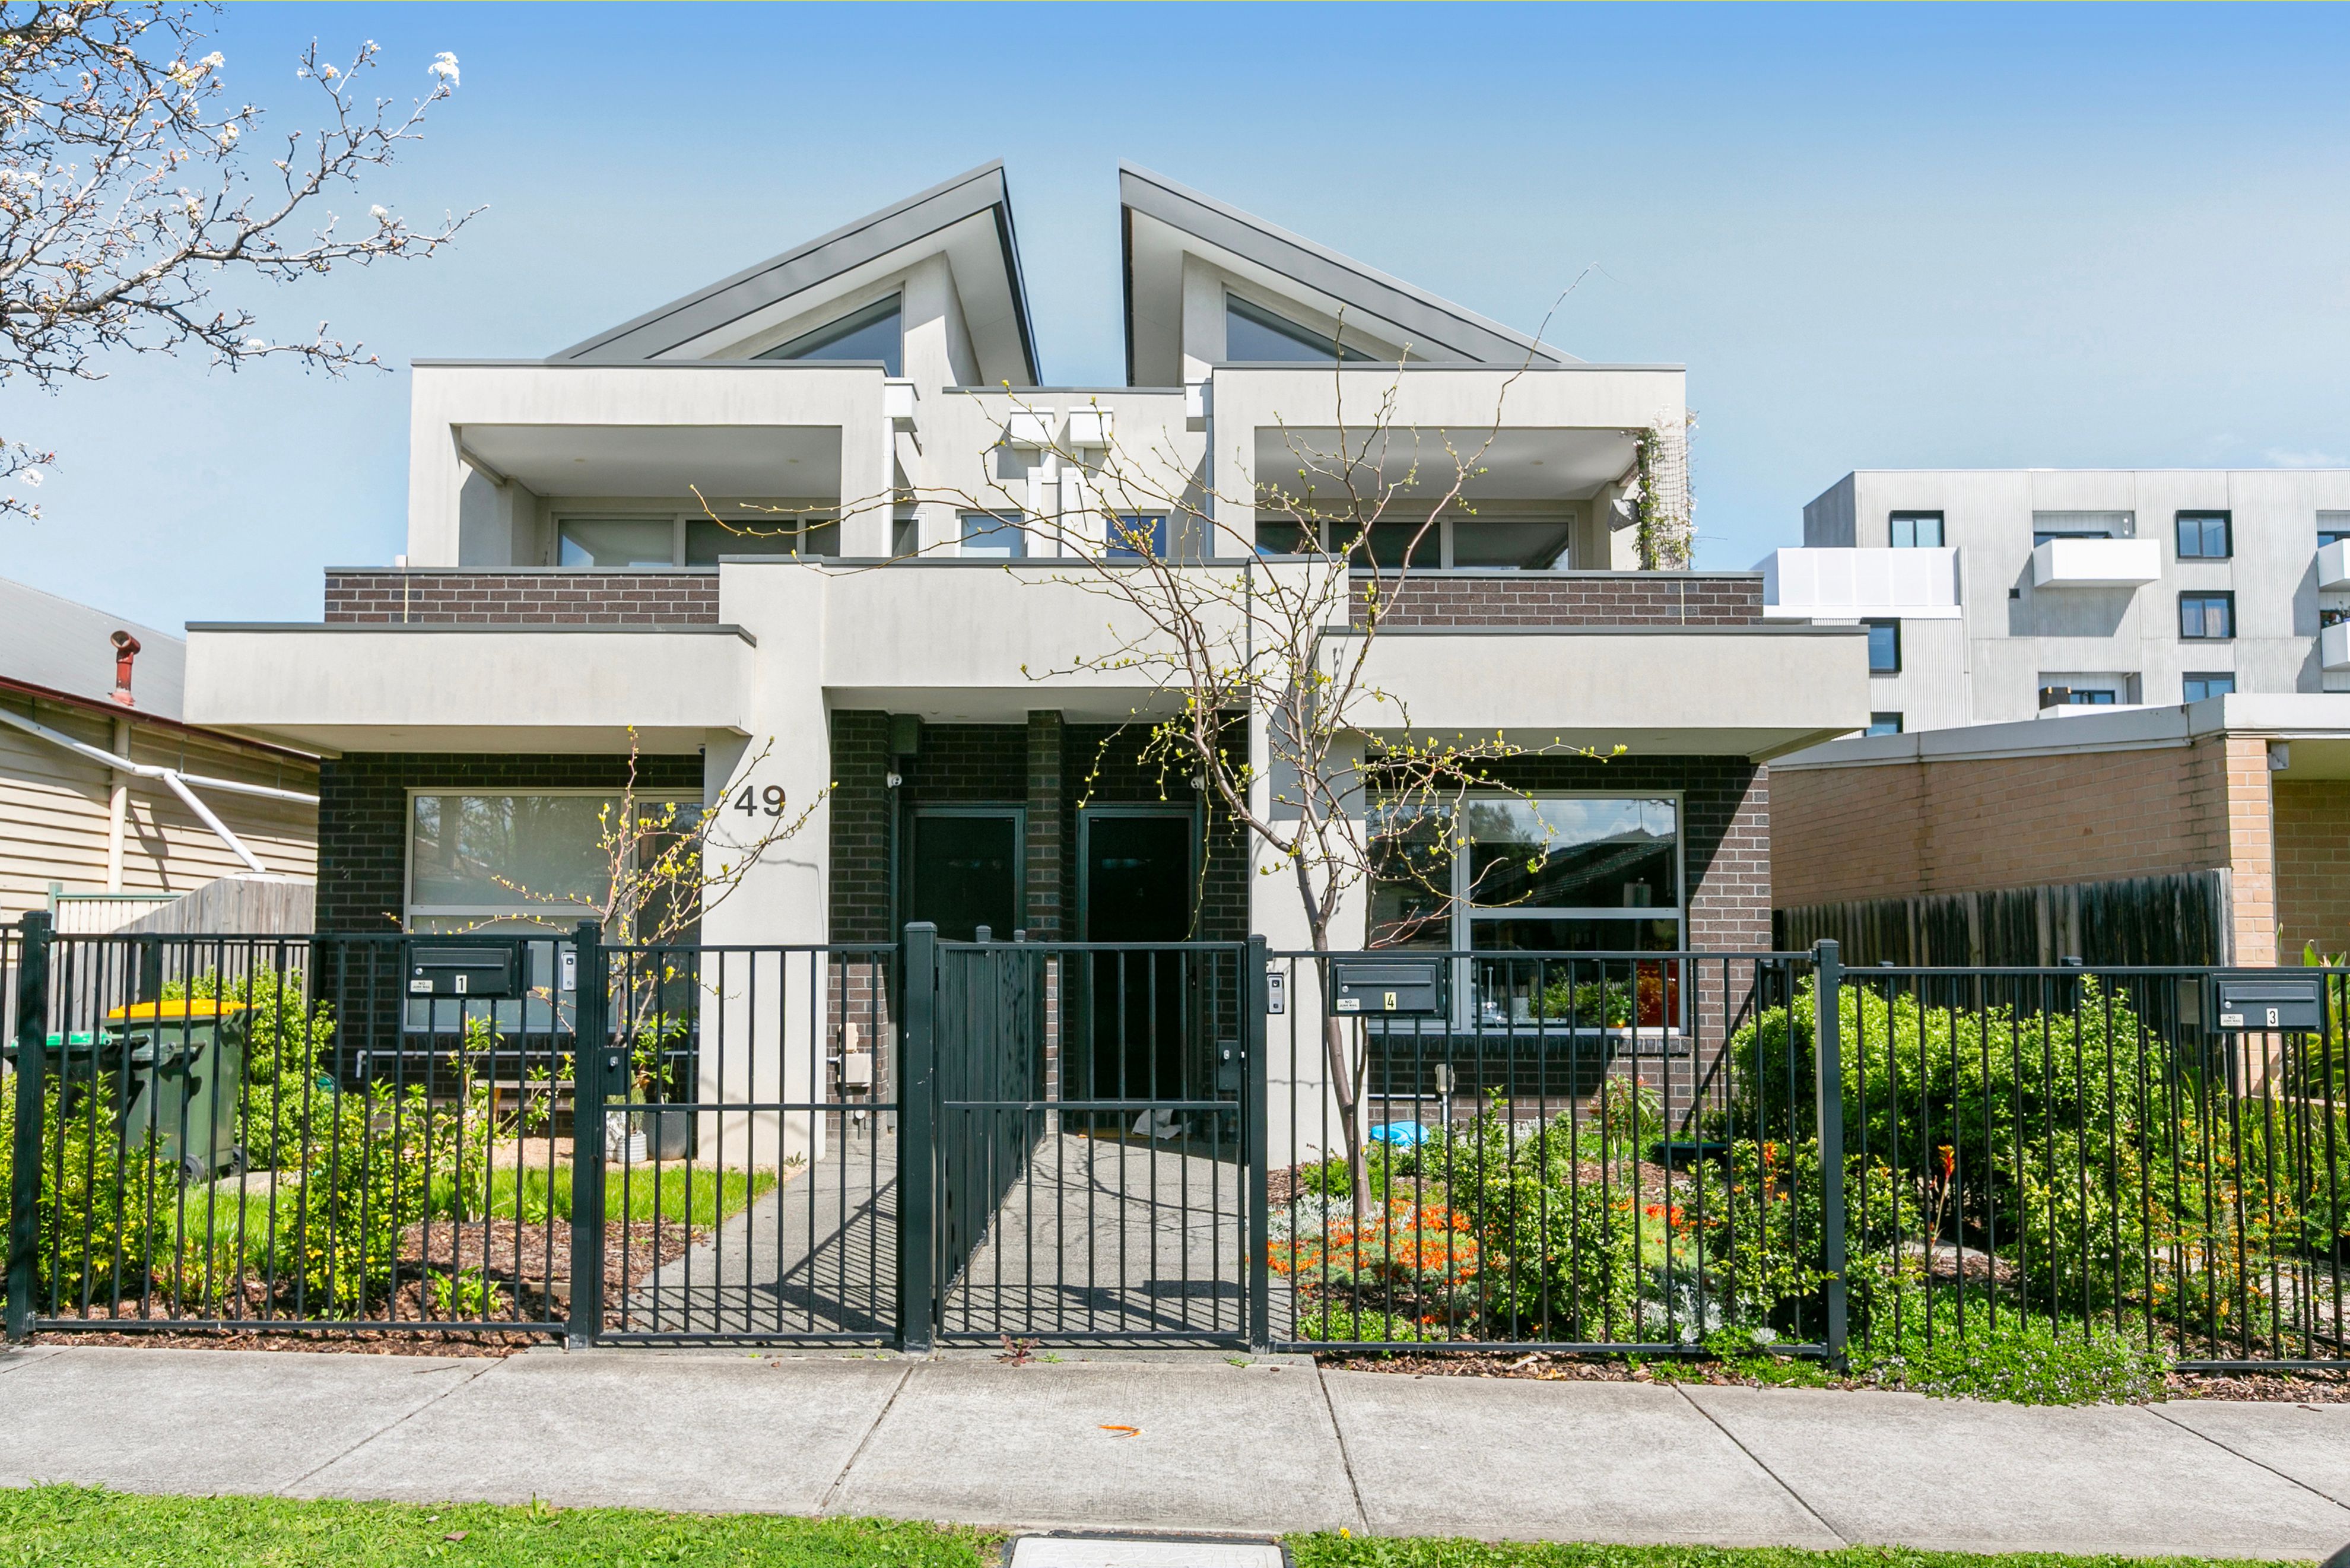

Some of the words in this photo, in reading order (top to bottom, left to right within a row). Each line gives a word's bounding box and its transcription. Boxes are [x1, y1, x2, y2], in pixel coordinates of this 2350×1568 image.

[734, 785, 786, 817] 49
[459, 977, 463, 991] 1
[1387, 994, 1394, 1007] 4
[2270, 1011, 2276, 1024] 3
